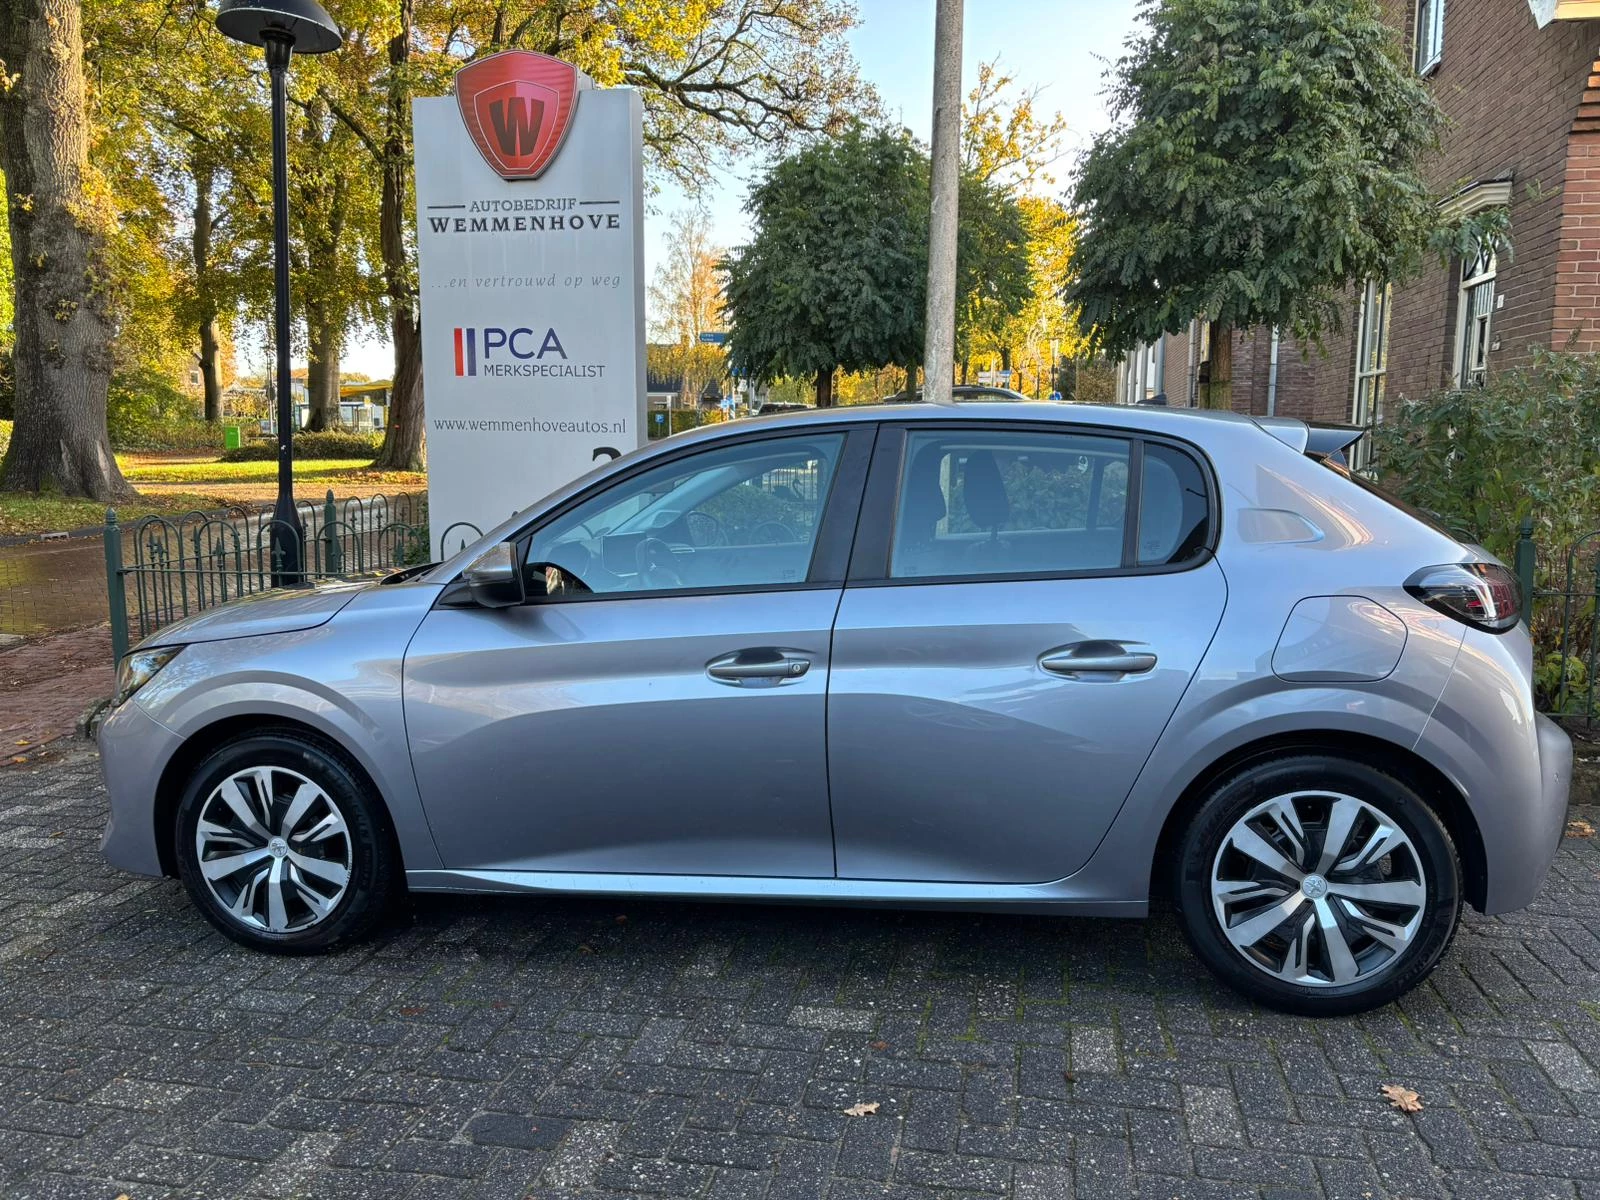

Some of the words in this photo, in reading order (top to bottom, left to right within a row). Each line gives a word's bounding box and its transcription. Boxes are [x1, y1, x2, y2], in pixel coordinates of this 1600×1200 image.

[489, 97, 545, 156] W
[469, 198, 577, 212] AUTOBEDRIJF
[427, 214, 620, 233] WEMMENHOVE
[475, 273, 557, 288] vertrouwd
[564, 276, 583, 289] op
[591, 275, 620, 289] weg
[484, 327, 568, 359] PCA
[484, 364, 605, 377] MERKSPECIALIST
[434, 418, 626, 433] www.wemmenhoveautos.nl
